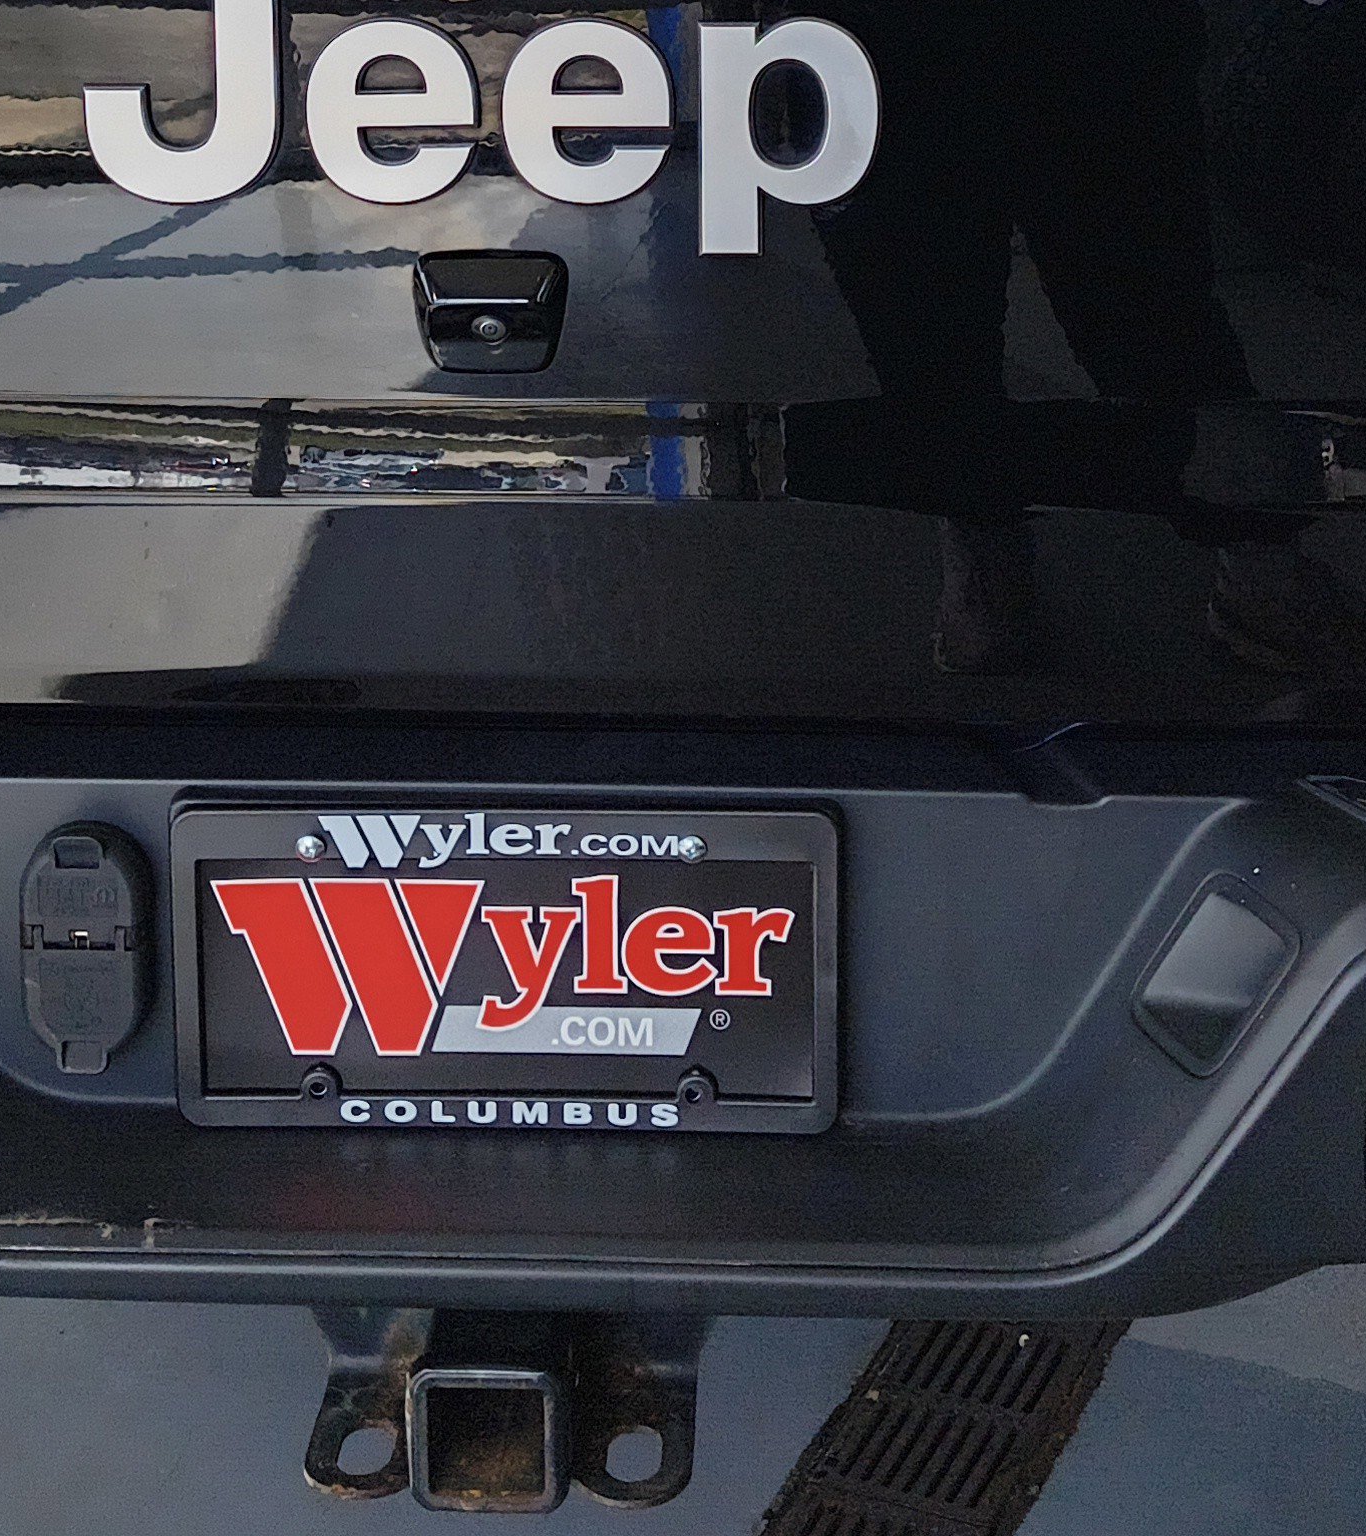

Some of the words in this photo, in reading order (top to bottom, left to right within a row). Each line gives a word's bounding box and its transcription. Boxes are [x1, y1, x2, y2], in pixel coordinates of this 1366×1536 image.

[209, 874, 795, 1056] Wyler
[550, 1016, 655, 1048] .COM
[340, 1099, 680, 1128] COLUMBUS
